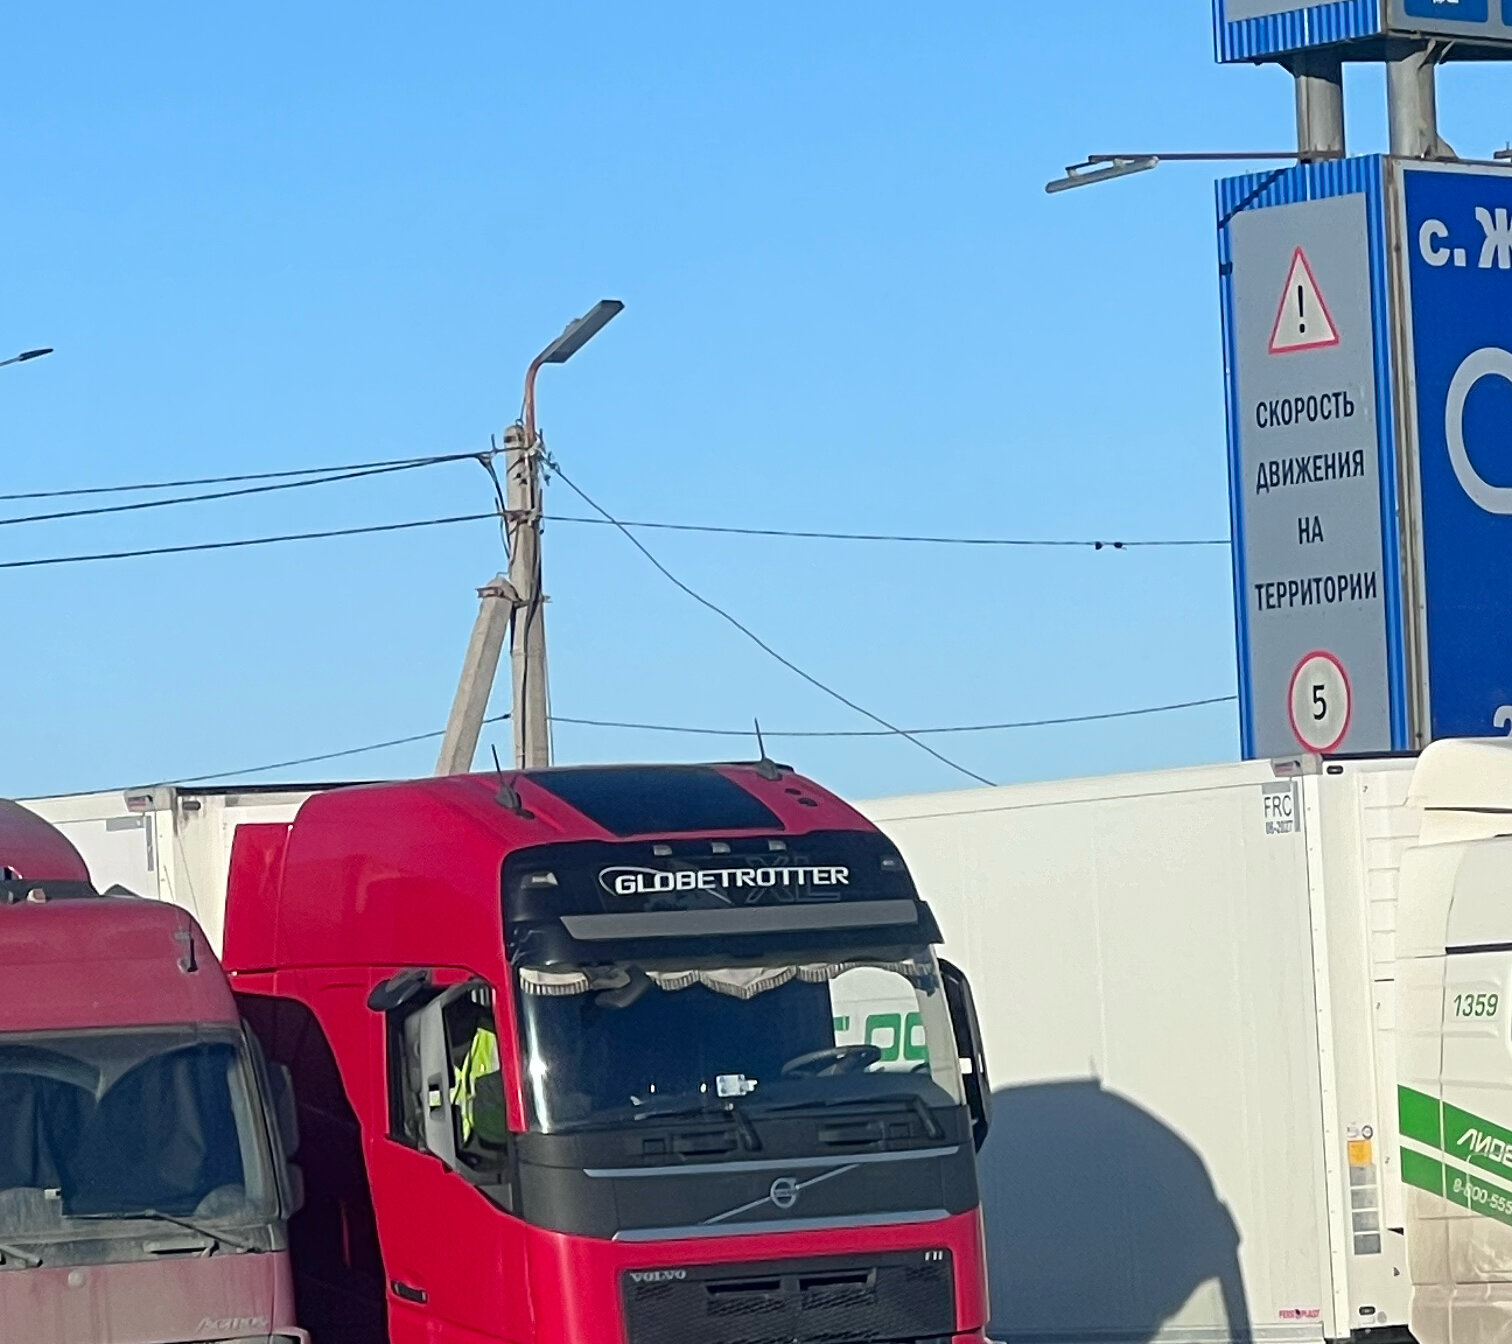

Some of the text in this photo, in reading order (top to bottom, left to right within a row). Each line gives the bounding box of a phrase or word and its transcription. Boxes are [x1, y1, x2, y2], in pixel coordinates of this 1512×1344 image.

[1418, 218, 1466, 268] с.
[1255, 390, 1355, 430] СКОРОСТЬ
[1255, 448, 1365, 495] ДВИЖЕНИЯ
[1297, 515, 1324, 545] НА
[1254, 570, 1378, 612] ТЕРРИТОРИИ
[1312, 684, 1326, 720] 5
[1264, 795, 1292, 817] FRC
[615, 866, 849, 896] GLOBETROTTER
[1454, 993, 1499, 1017] 1359
[629, 1269, 687, 1282] VOLVO
